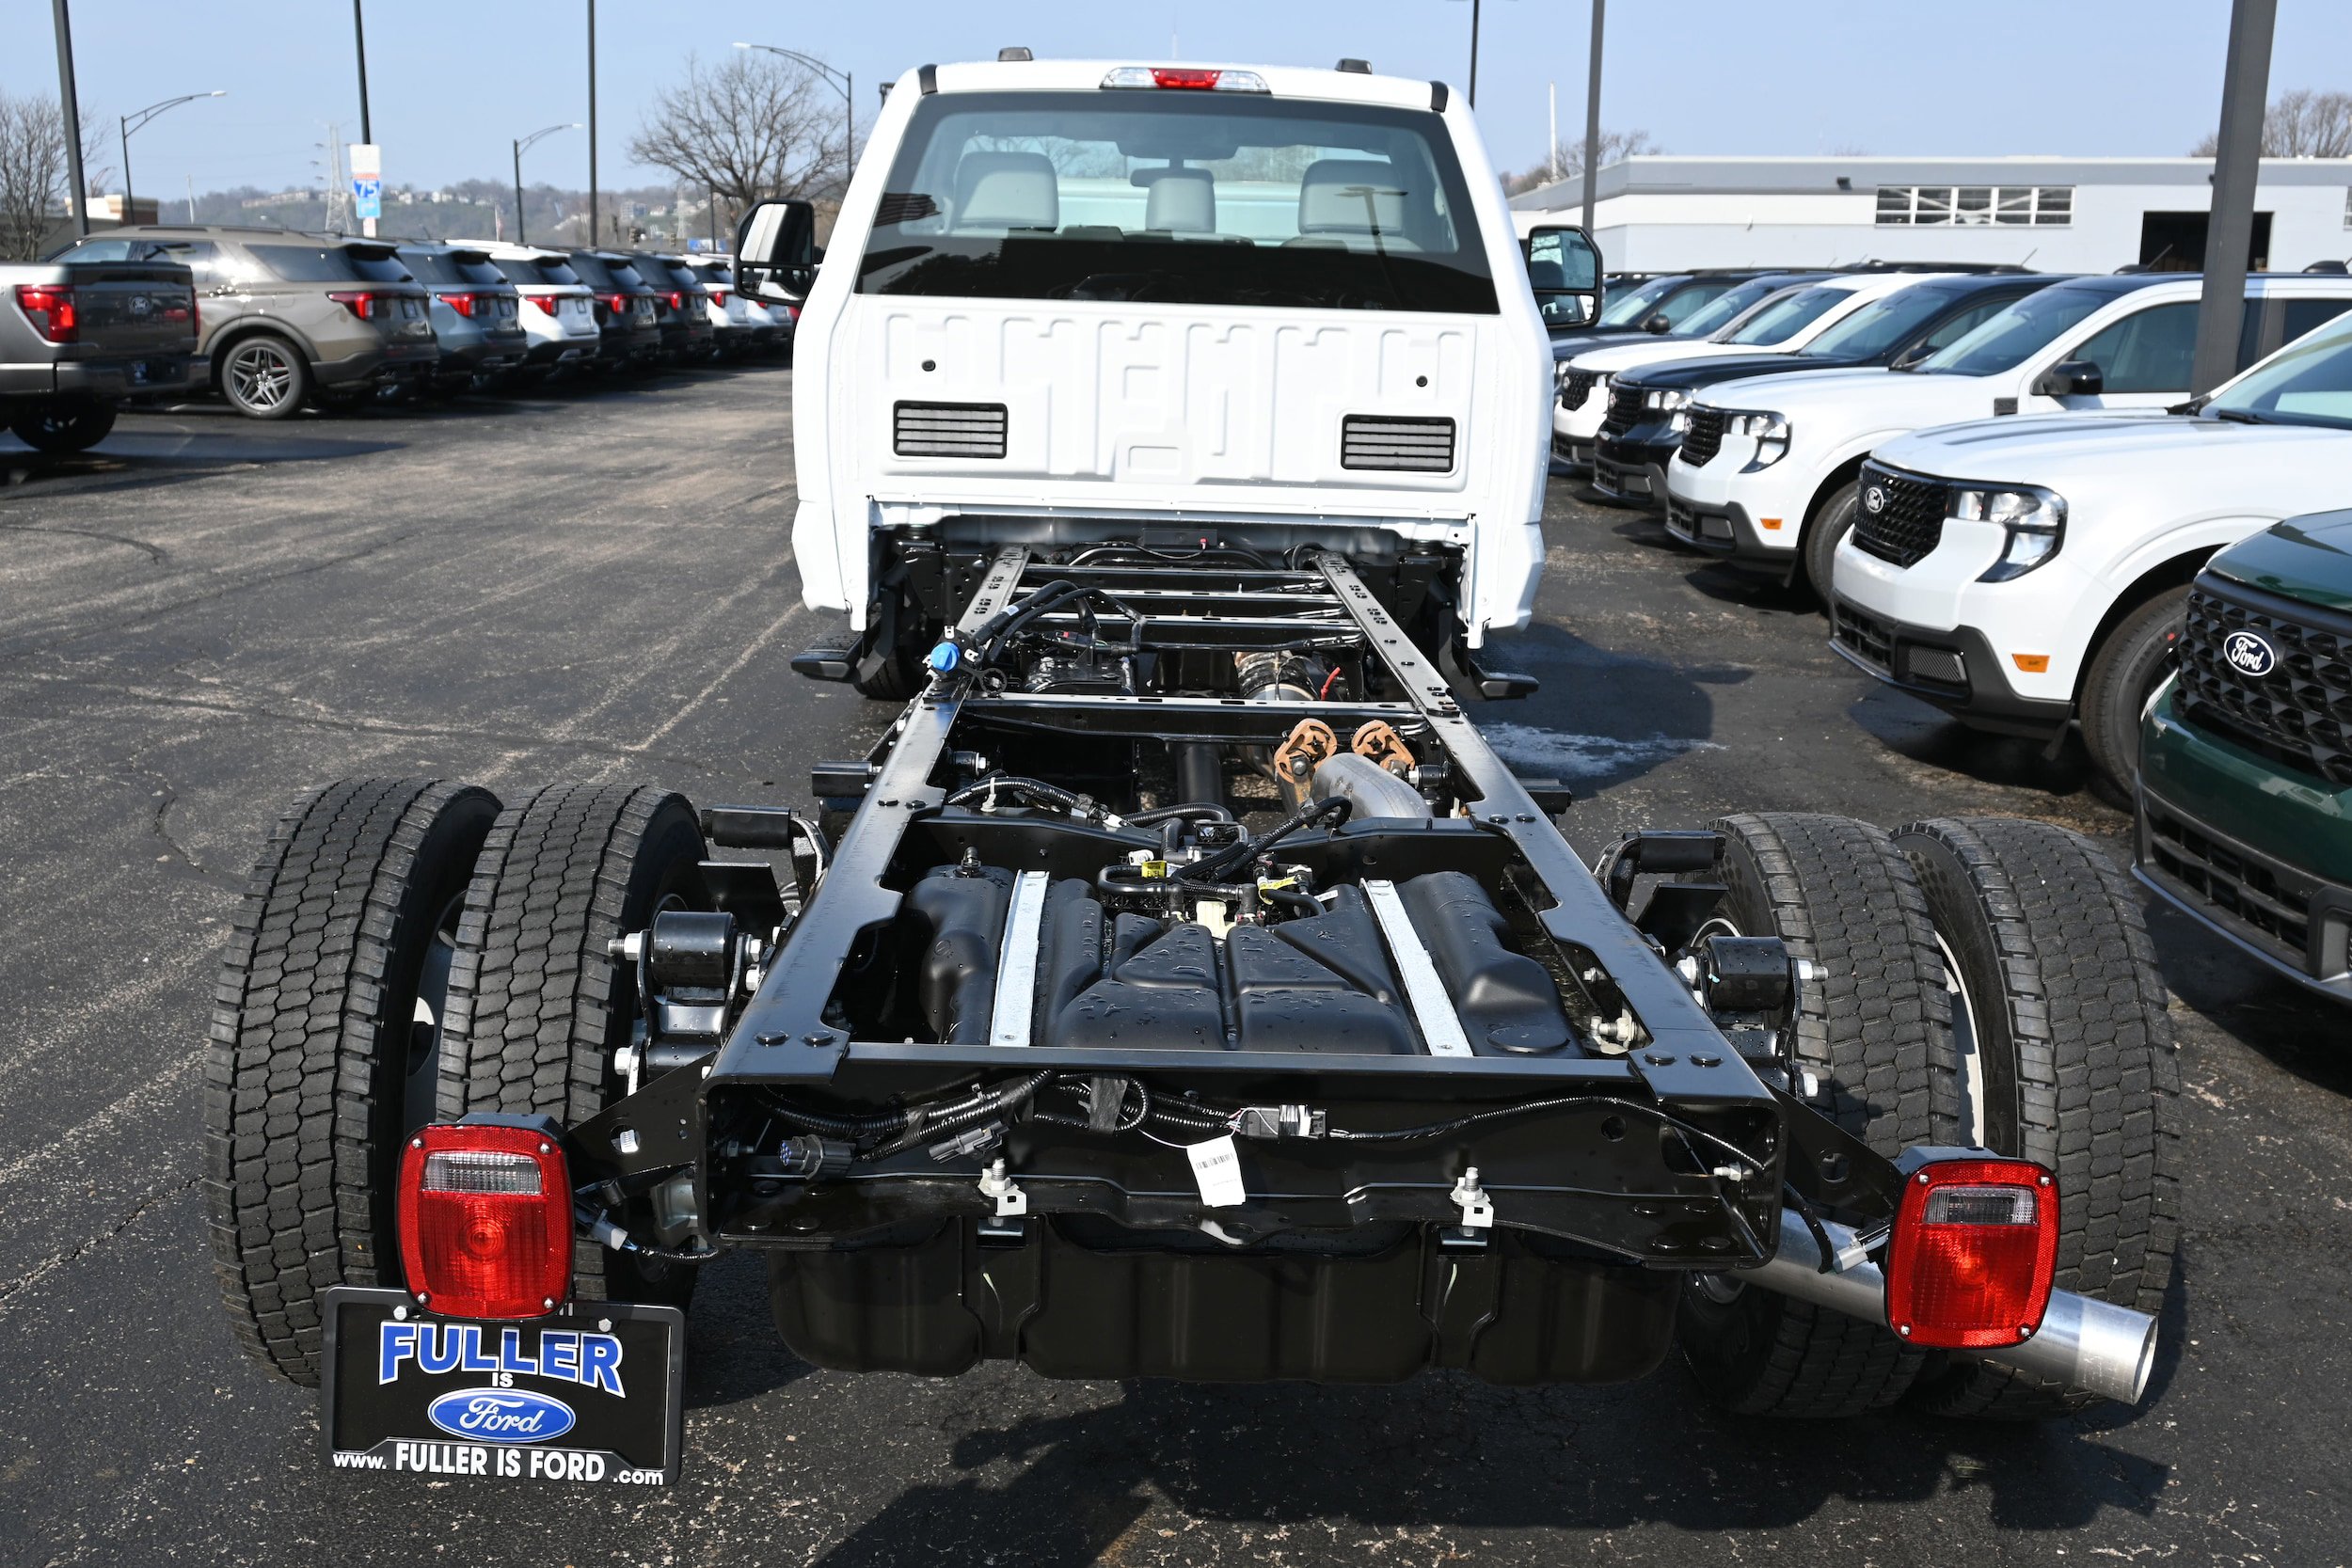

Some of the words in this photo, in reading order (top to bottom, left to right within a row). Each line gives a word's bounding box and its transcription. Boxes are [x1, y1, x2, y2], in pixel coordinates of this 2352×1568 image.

[356, 180, 378, 198] 75
[2232, 636, 2265, 671] Ford
[379, 1321, 627, 1399] FULLER
[491, 1371, 514, 1387] IS
[459, 1396, 545, 1435] Ford
[332, 1452, 388, 1470] www.
[395, 1442, 488, 1477] FULLER
[497, 1449, 521, 1478] IS
[530, 1449, 606, 1482] FORD
[612, 1468, 664, 1486] .com
